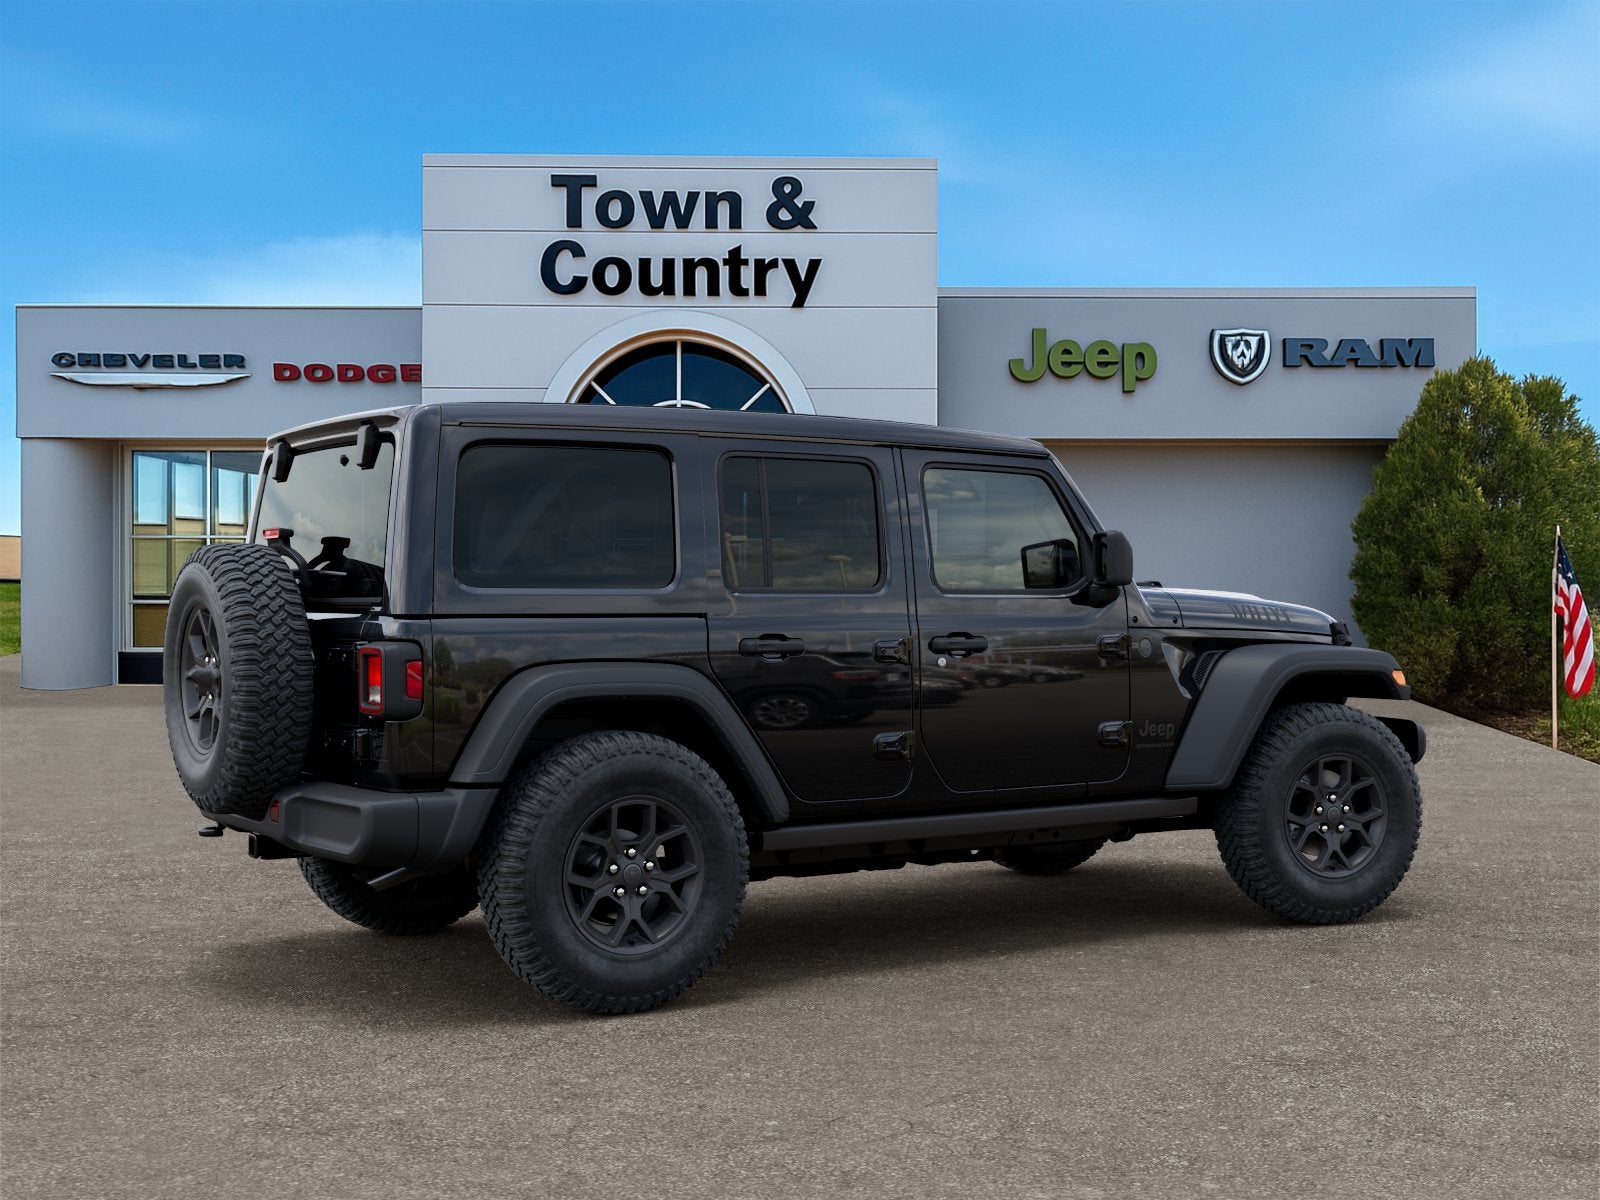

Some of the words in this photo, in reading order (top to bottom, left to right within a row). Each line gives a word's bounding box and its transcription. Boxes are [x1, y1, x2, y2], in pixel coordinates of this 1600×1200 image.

[550, 173, 742, 229] Town
[765, 176, 818, 230] &
[540, 239, 822, 308] Country
[272, 362, 422, 384] DODGE
[1008, 328, 1158, 393] Jeep
[1282, 337, 1436, 368] RAM
[1138, 719, 1175, 739] Jeep
